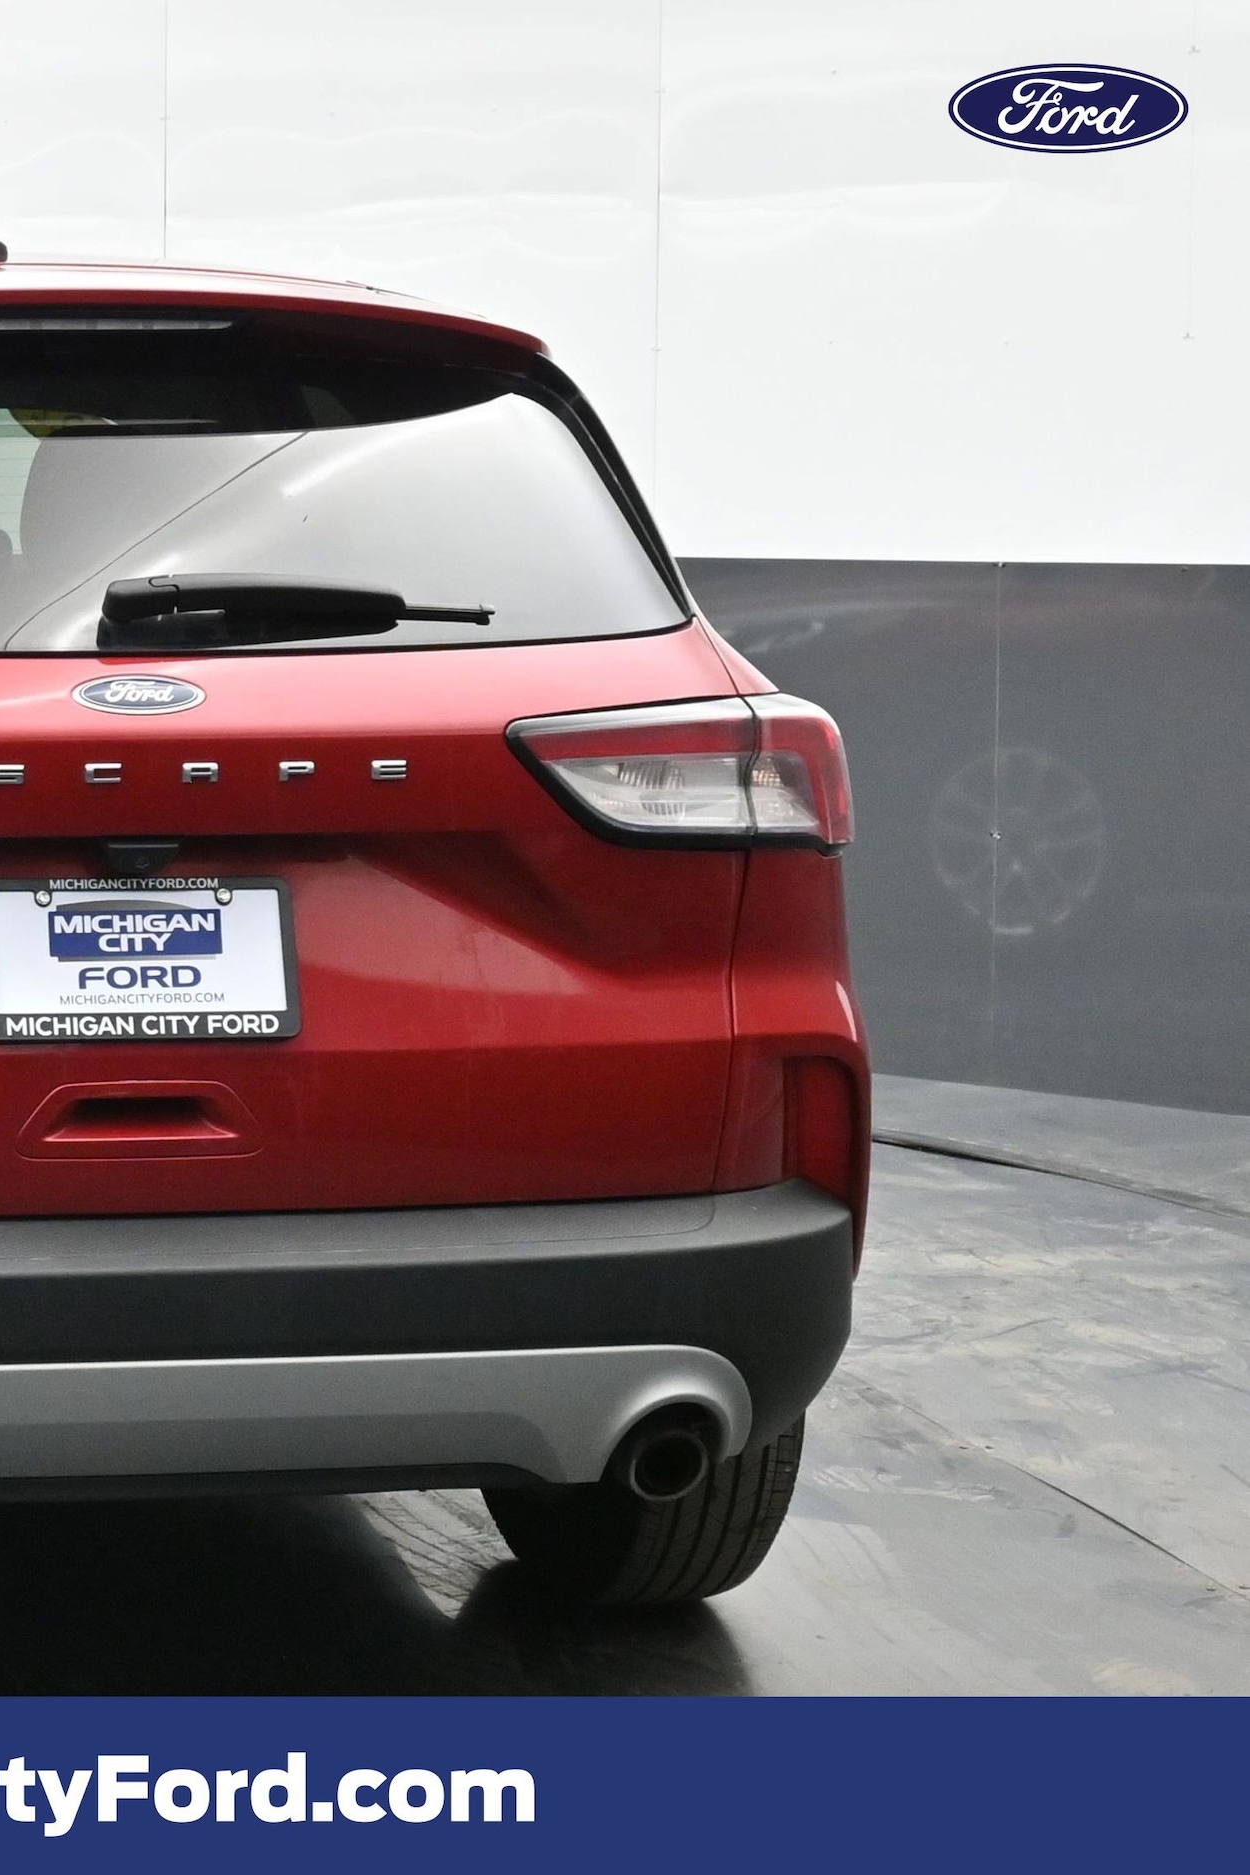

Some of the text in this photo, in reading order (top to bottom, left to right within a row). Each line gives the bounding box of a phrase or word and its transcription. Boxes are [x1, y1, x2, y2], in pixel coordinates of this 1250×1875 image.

[104, 680, 174, 704] Ford
[50, 878, 219, 890] MICHIGANCITYFORD.COM
[53, 912, 216, 934] MICHIGAN
[99, 933, 171, 952] CITY
[78, 966, 202, 989] FORD
[60, 992, 225, 1005] MICHIGANCITYFORD.COM
[5, 1013, 280, 1037] MICHIGAN CITY FORD
